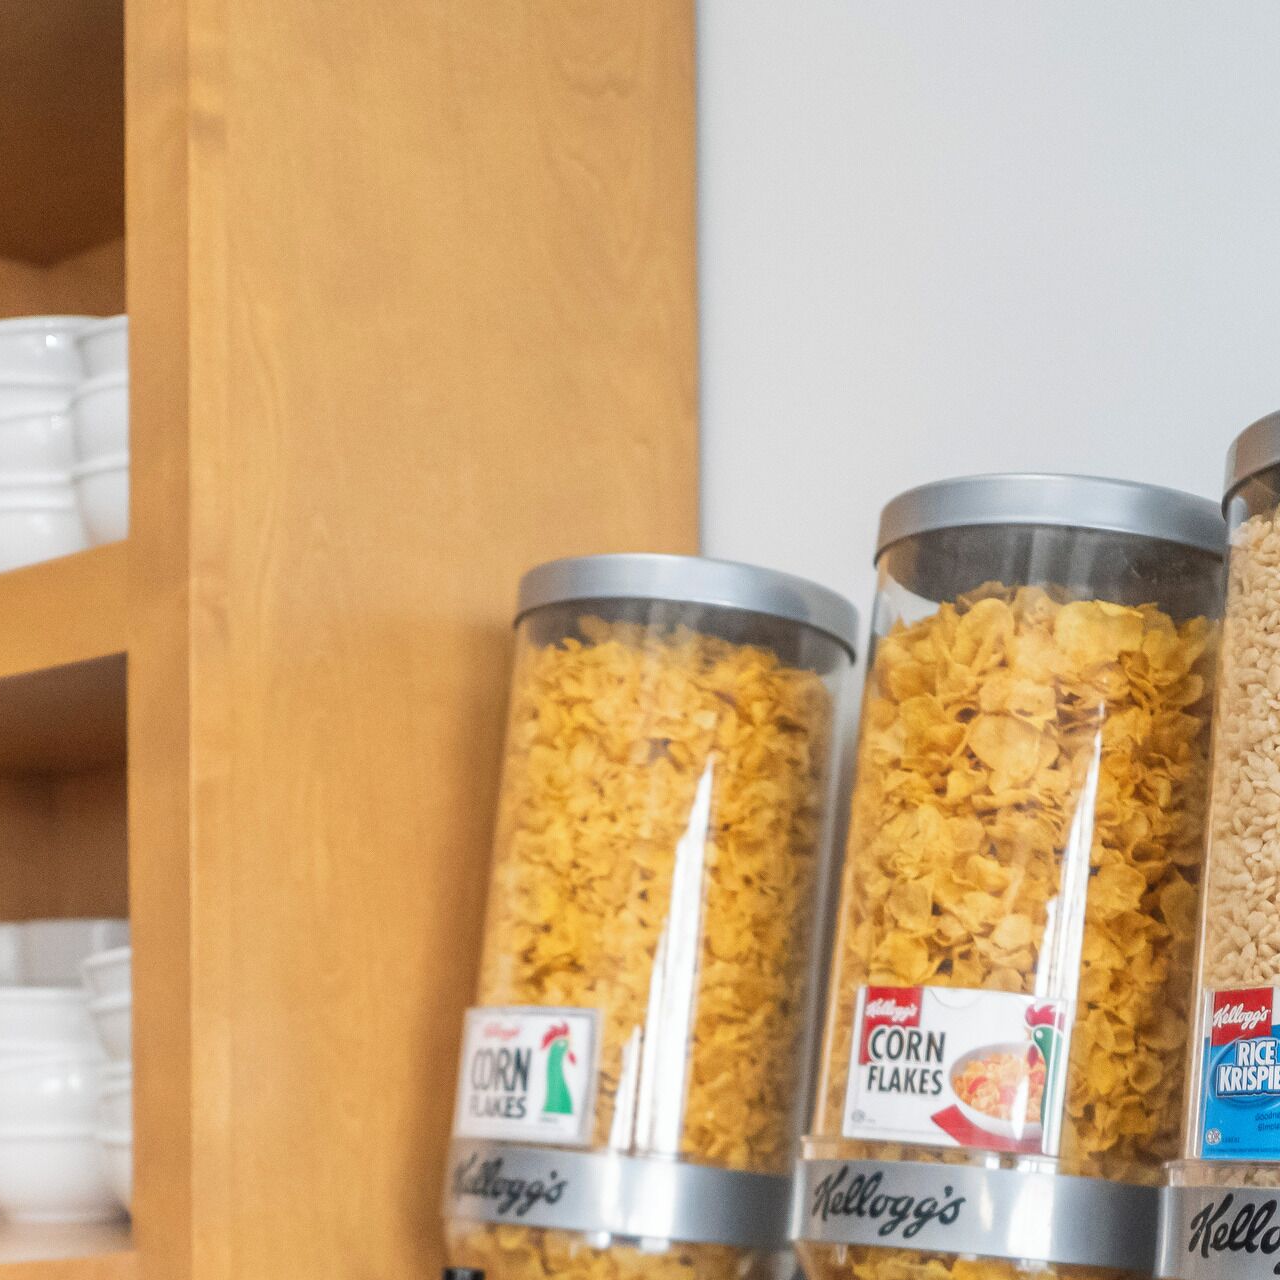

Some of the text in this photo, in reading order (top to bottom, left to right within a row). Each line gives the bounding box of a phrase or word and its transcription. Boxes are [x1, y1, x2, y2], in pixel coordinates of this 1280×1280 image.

[864, 998, 918, 1022] Kellogg's
[1213, 1003, 1271, 1030] Kellogg's
[871, 1027, 946, 1063] CORN
[1236, 1039, 1277, 1066] RICE
[867, 1065, 944, 1096] FLAKES
[811, 1165, 967, 1239] Kellogg's
